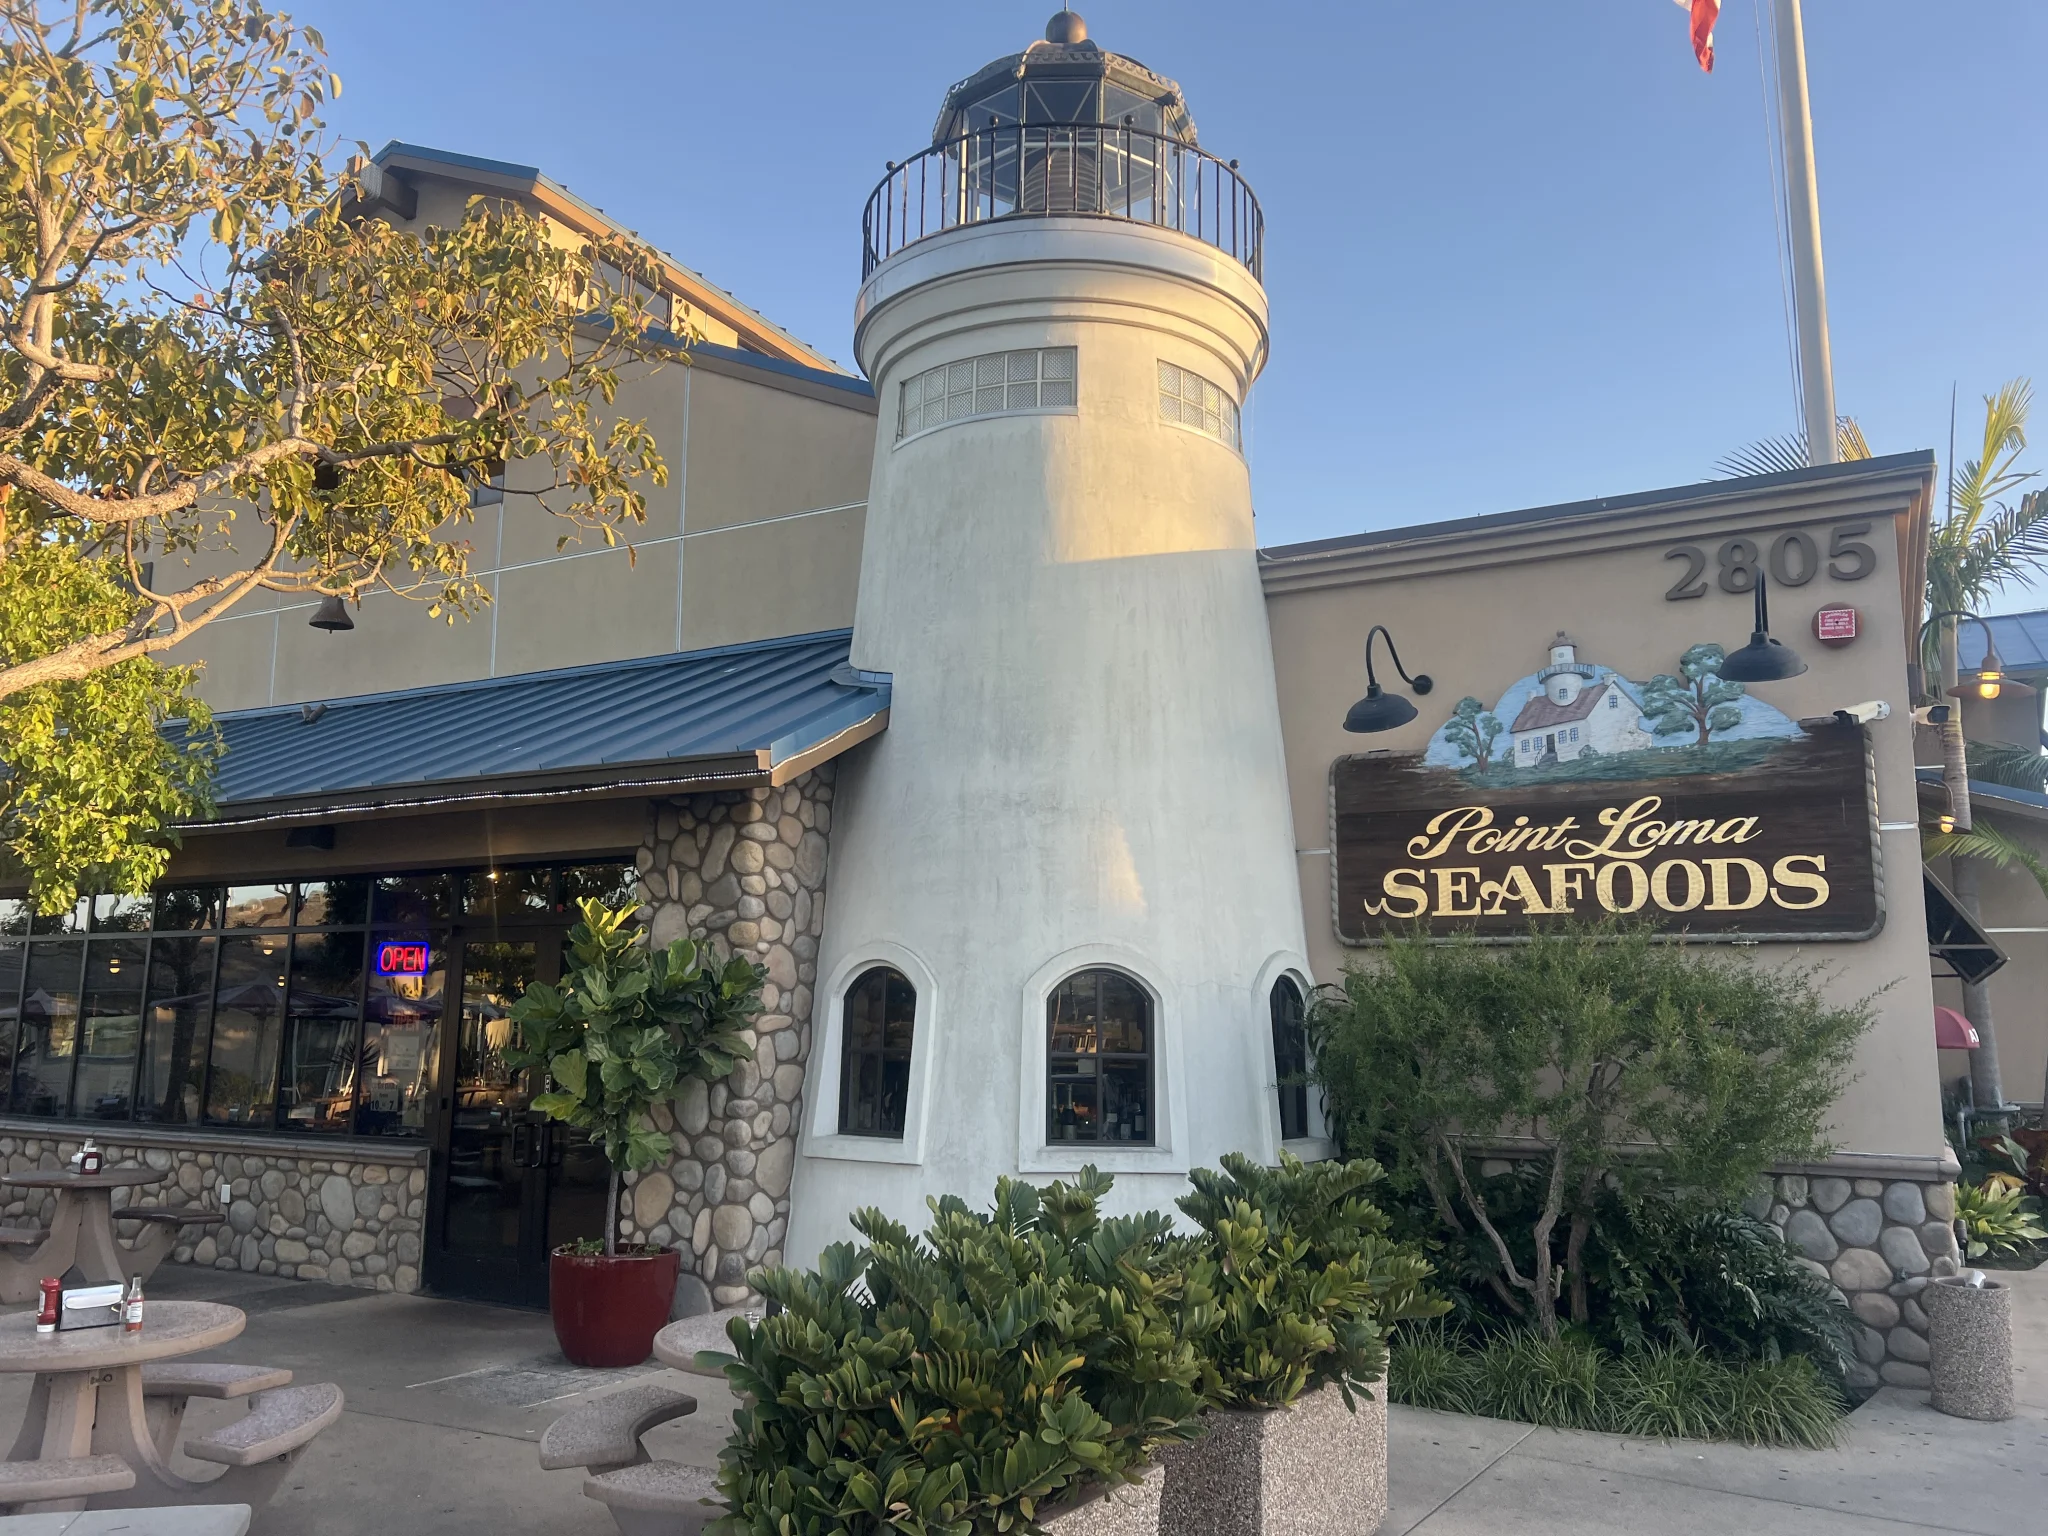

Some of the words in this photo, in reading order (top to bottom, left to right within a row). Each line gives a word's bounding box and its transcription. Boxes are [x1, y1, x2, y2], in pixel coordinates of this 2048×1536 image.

[1665, 522, 1877, 602] 2805
[1407, 806, 1577, 861] Point
[1565, 795, 1763, 861] Loma
[1364, 854, 1831, 920] SEAFOODS
[380, 947, 426, 971] OPEN
